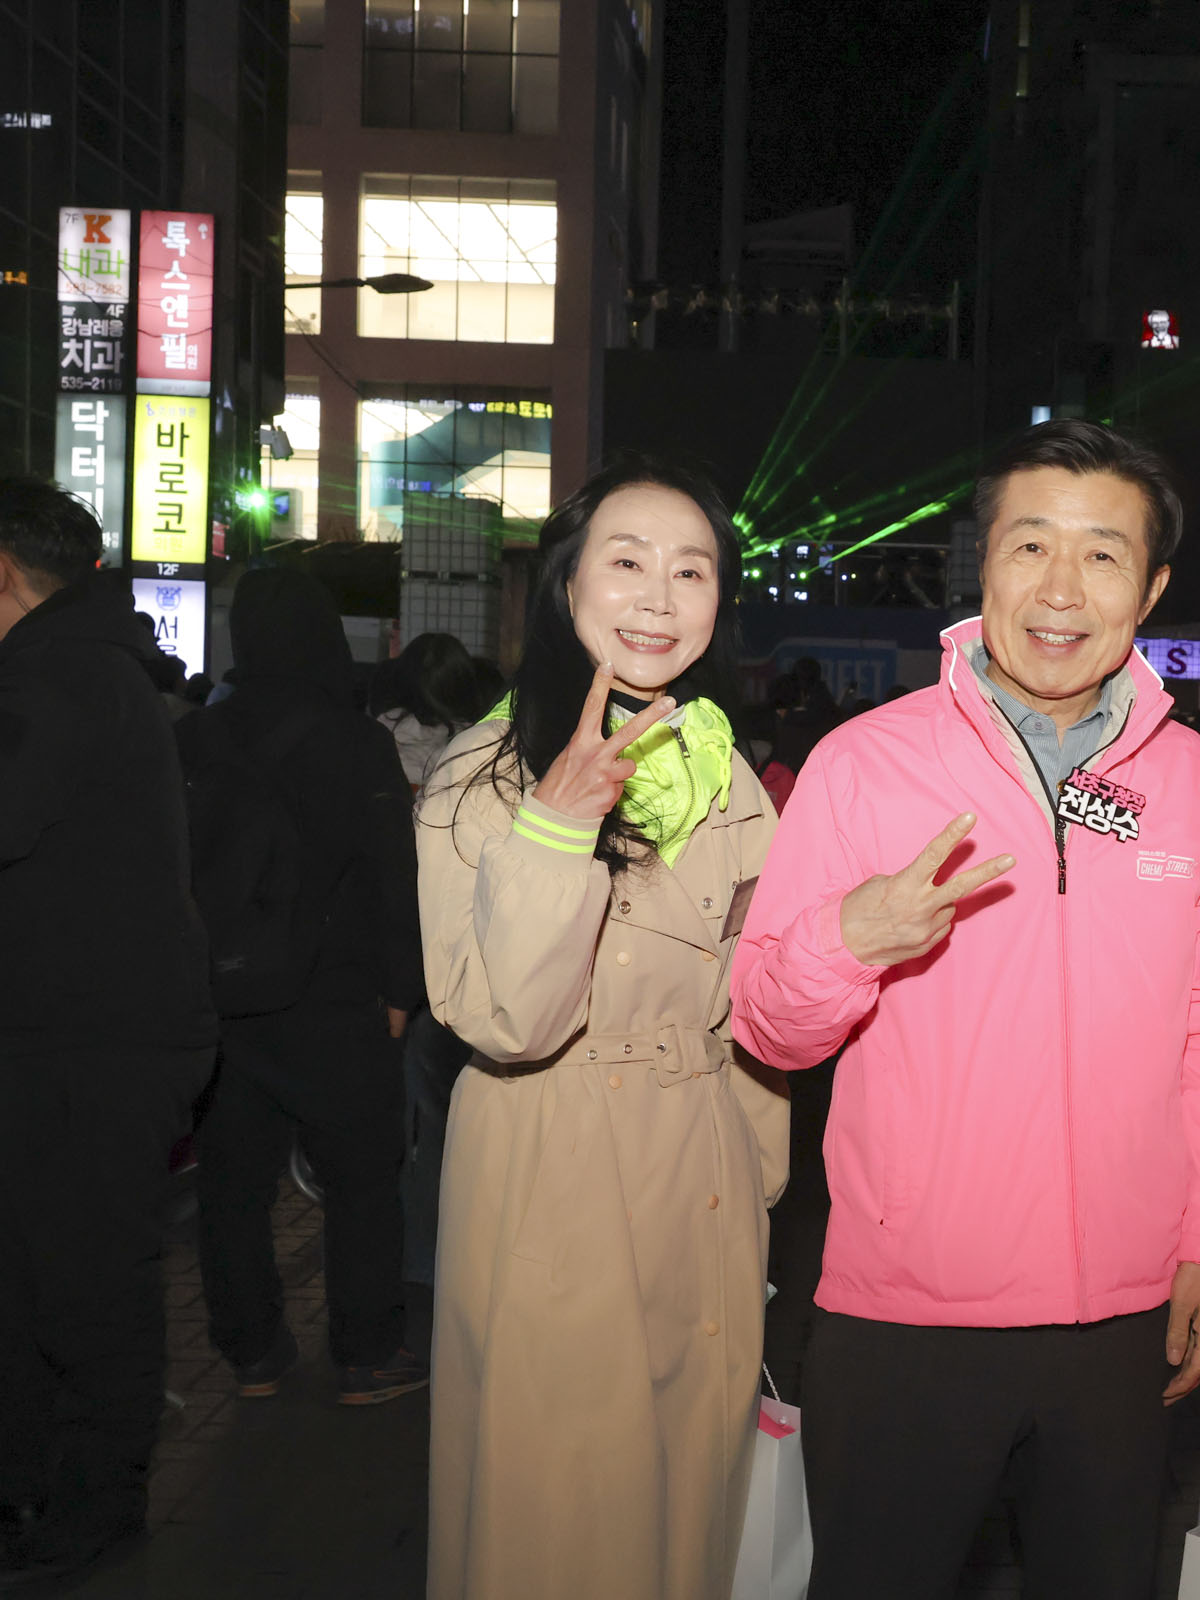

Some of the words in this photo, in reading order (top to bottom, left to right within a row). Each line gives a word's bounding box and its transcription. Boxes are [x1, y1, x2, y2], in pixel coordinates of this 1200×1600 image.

[83, 214, 112, 244] K
[63, 247, 125, 280] 내과
[61, 338, 124, 374] 치과
[153, 422, 190, 534] 바로코
[157, 563, 180, 576] 12F
[1066, 768, 1147, 815] 서초구청장
[1057, 784, 1139, 842] 전성수
